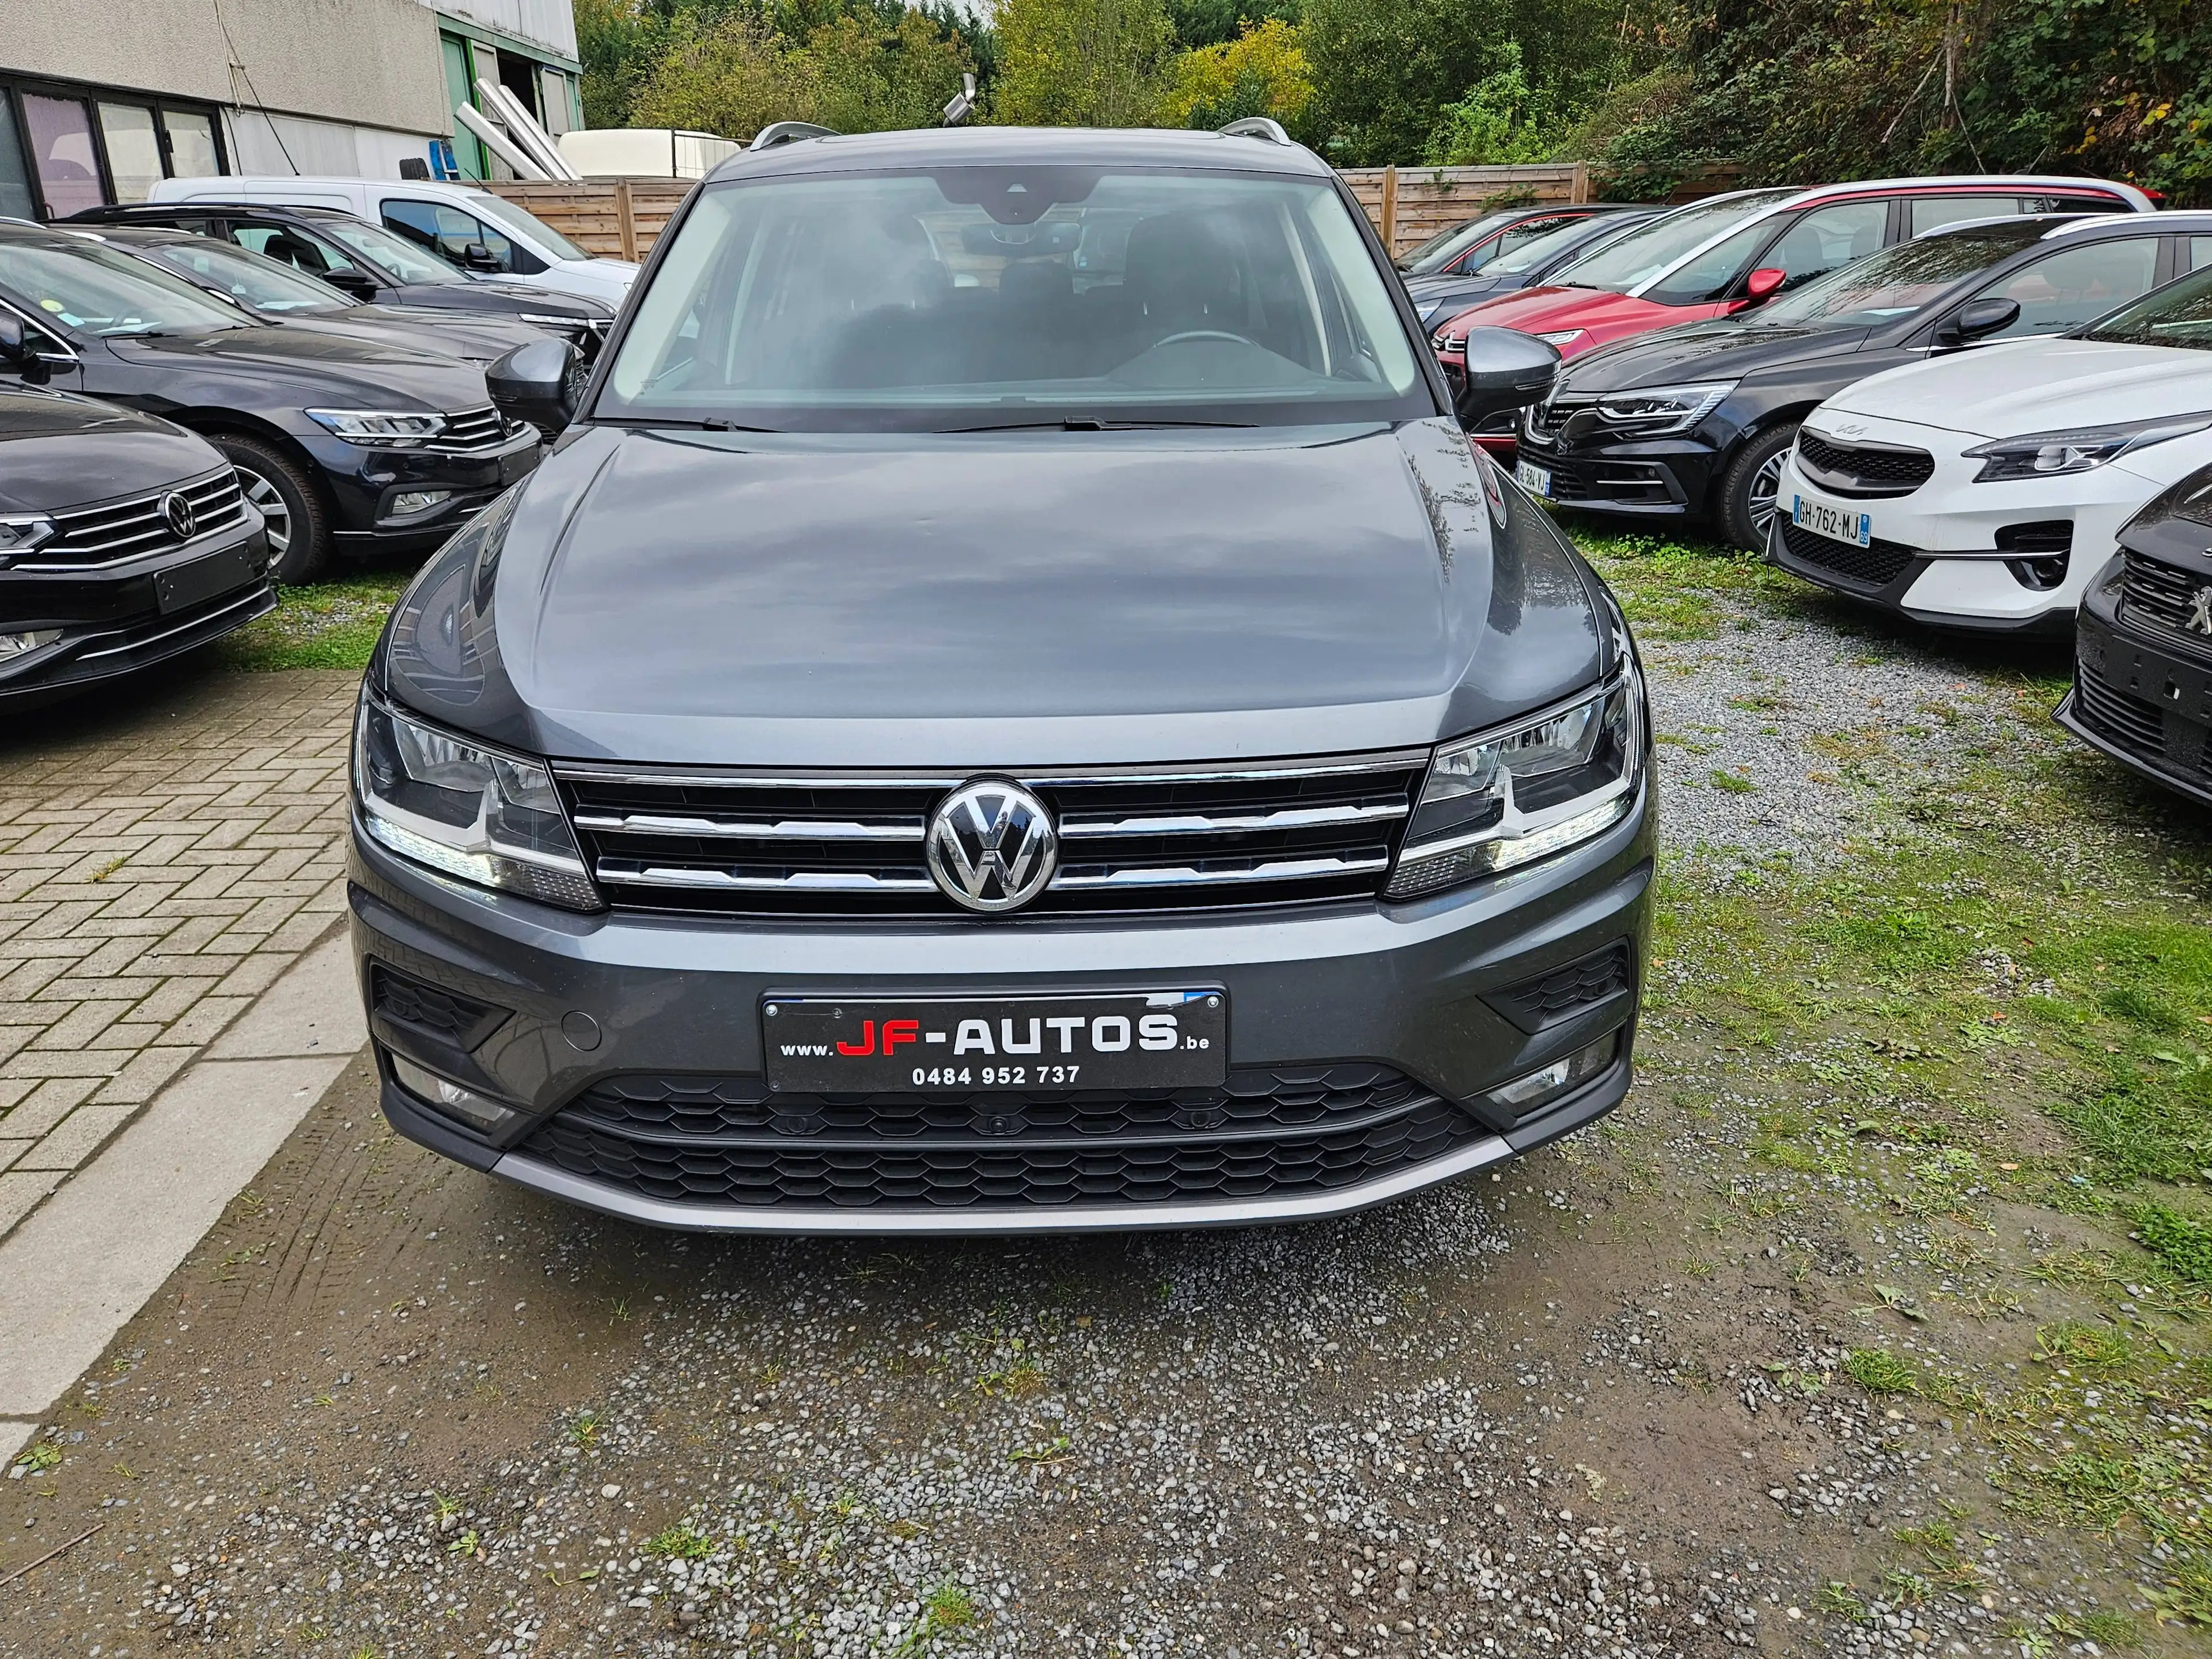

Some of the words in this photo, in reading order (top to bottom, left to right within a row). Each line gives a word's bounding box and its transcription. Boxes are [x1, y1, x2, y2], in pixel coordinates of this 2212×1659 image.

[1799, 501, 1859, 540] GH-762-MJ
[1861, 531, 1868, 543] 69
[930, 783, 1054, 910] VW
[912, 1067, 972, 1085] 0484
[982, 1066, 1025, 1085] 952
[1037, 1065, 1080, 1084] 737
